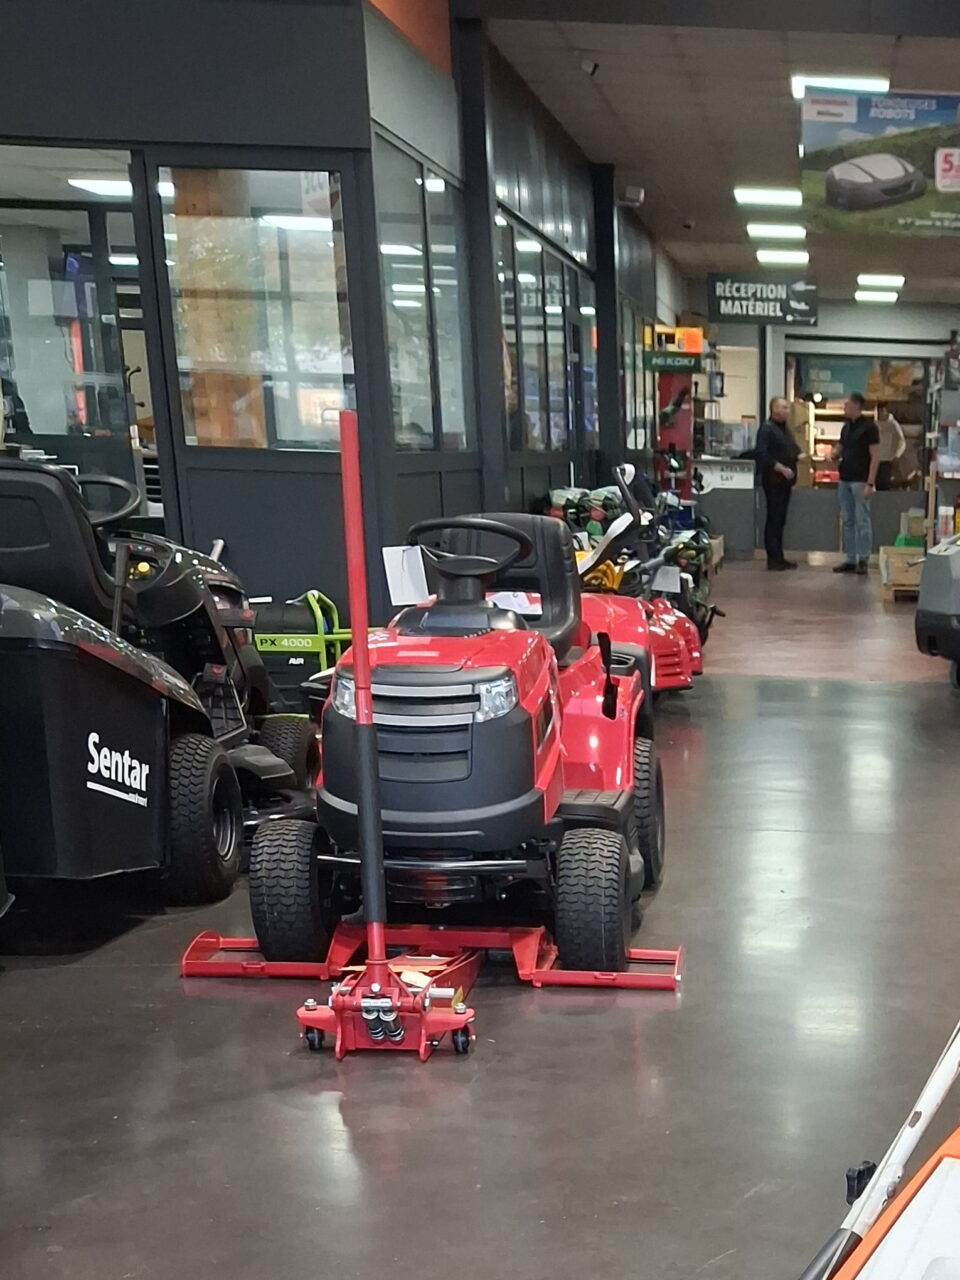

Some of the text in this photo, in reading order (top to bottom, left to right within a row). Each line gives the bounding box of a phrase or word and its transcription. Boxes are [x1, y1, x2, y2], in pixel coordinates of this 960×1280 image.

[942, 153, 954, 173] 5
[715, 279, 787, 300] RÉCEPTION
[720, 297, 783, 317] MATÉRIEL
[260, 638, 313, 647] PX 4000
[87, 732, 150, 792] Sentar
